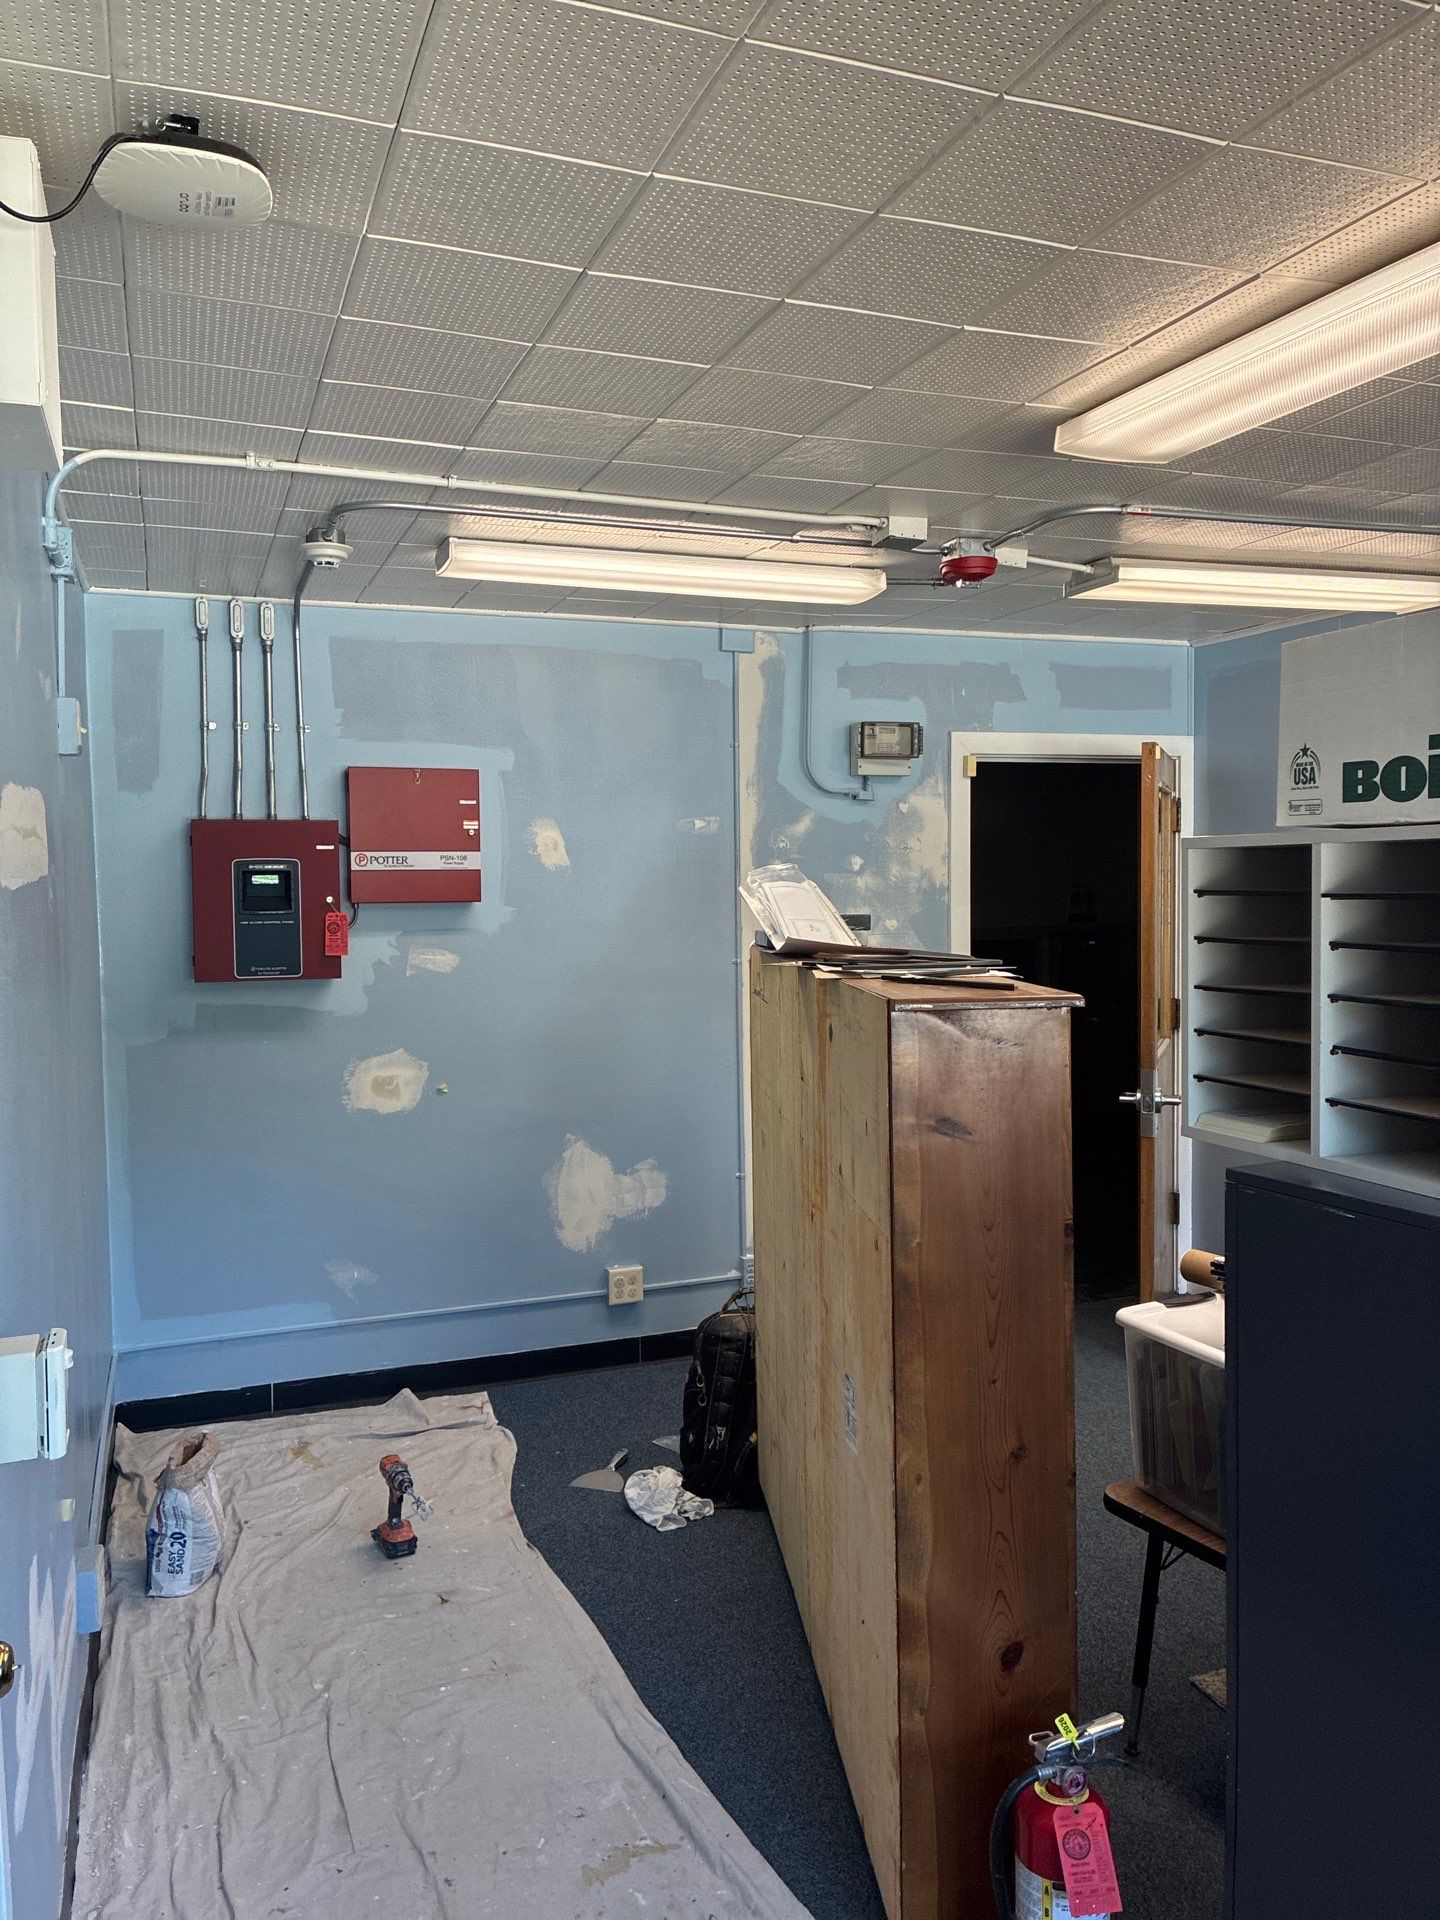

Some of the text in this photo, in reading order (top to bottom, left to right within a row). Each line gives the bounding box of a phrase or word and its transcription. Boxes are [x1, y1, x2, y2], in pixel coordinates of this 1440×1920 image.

[179, 192, 190, 213] aruba
[1293, 766, 1317, 786] USA
[370, 855, 409, 865] POTTER
[440, 854, 468, 862] PSN-106
[169, 1531, 187, 1548] 20
[167, 1550, 177, 1574] EASY
[175, 1548, 186, 1575] SAND
[1057, 1716, 1073, 1736] 2026
